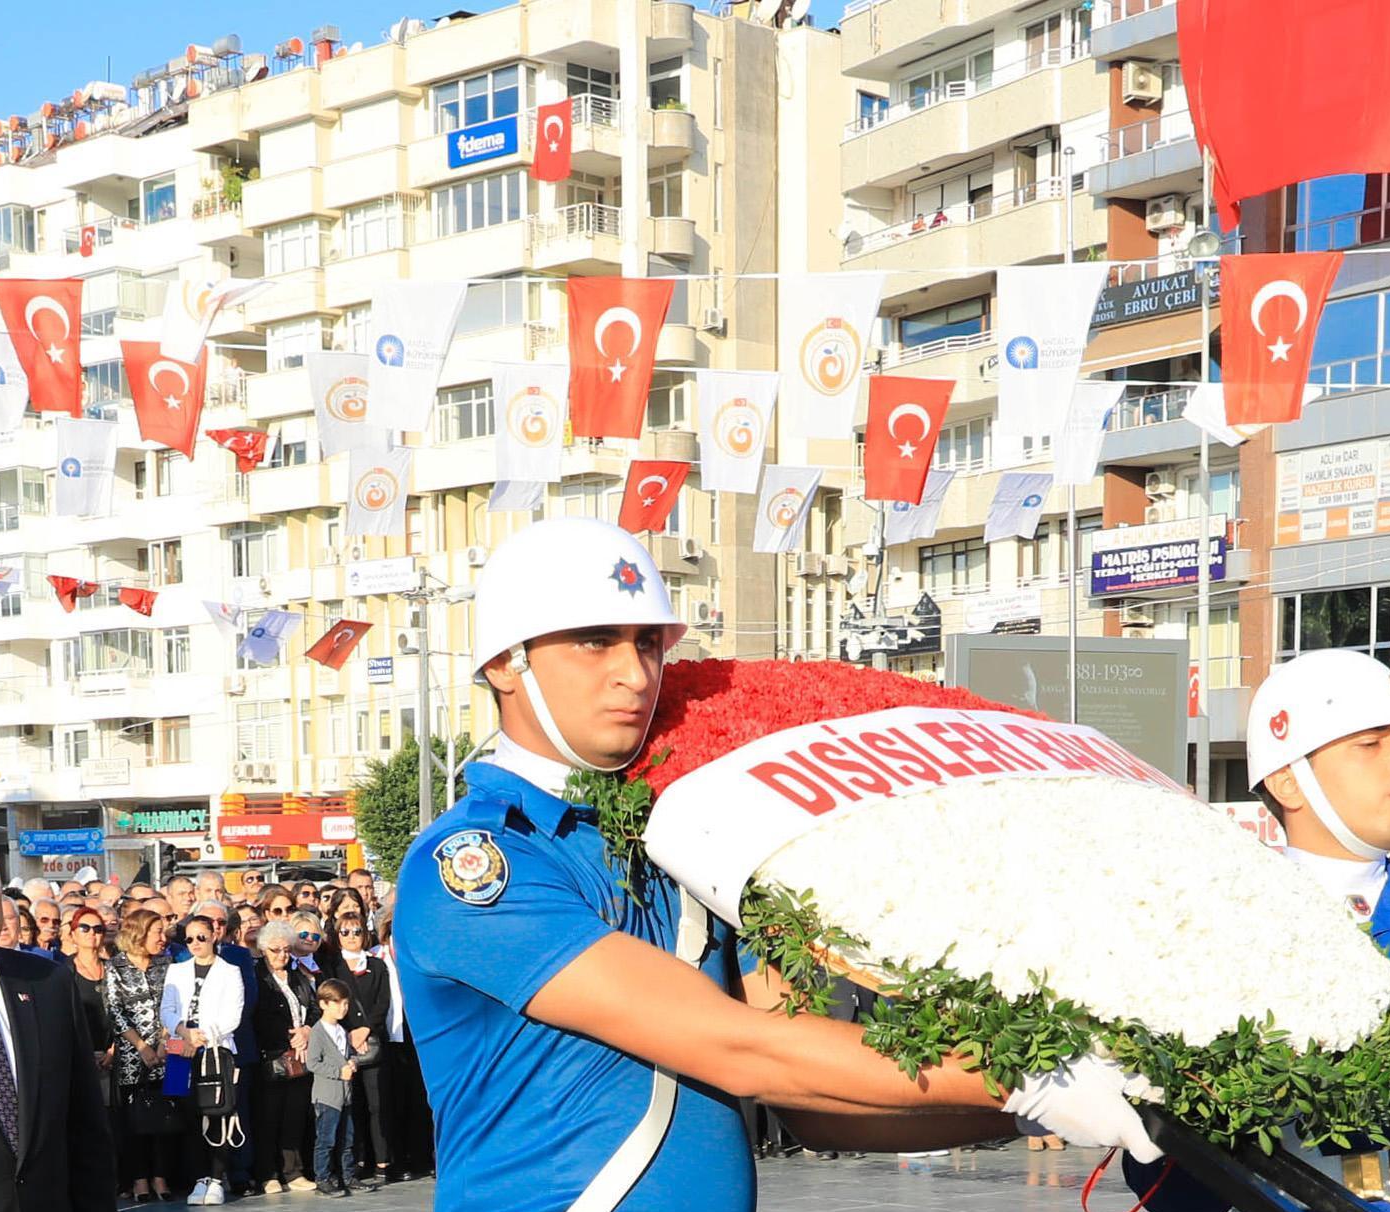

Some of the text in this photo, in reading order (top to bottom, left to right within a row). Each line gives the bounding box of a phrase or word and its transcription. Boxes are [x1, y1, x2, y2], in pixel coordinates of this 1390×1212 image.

[1132, 274, 1188, 299] AVUKAT
[1124, 285, 1197, 316] EBRU ÇEBİ
[1101, 549, 1150, 568] MATRİS
[133, 809, 207, 833] PHARMACY
